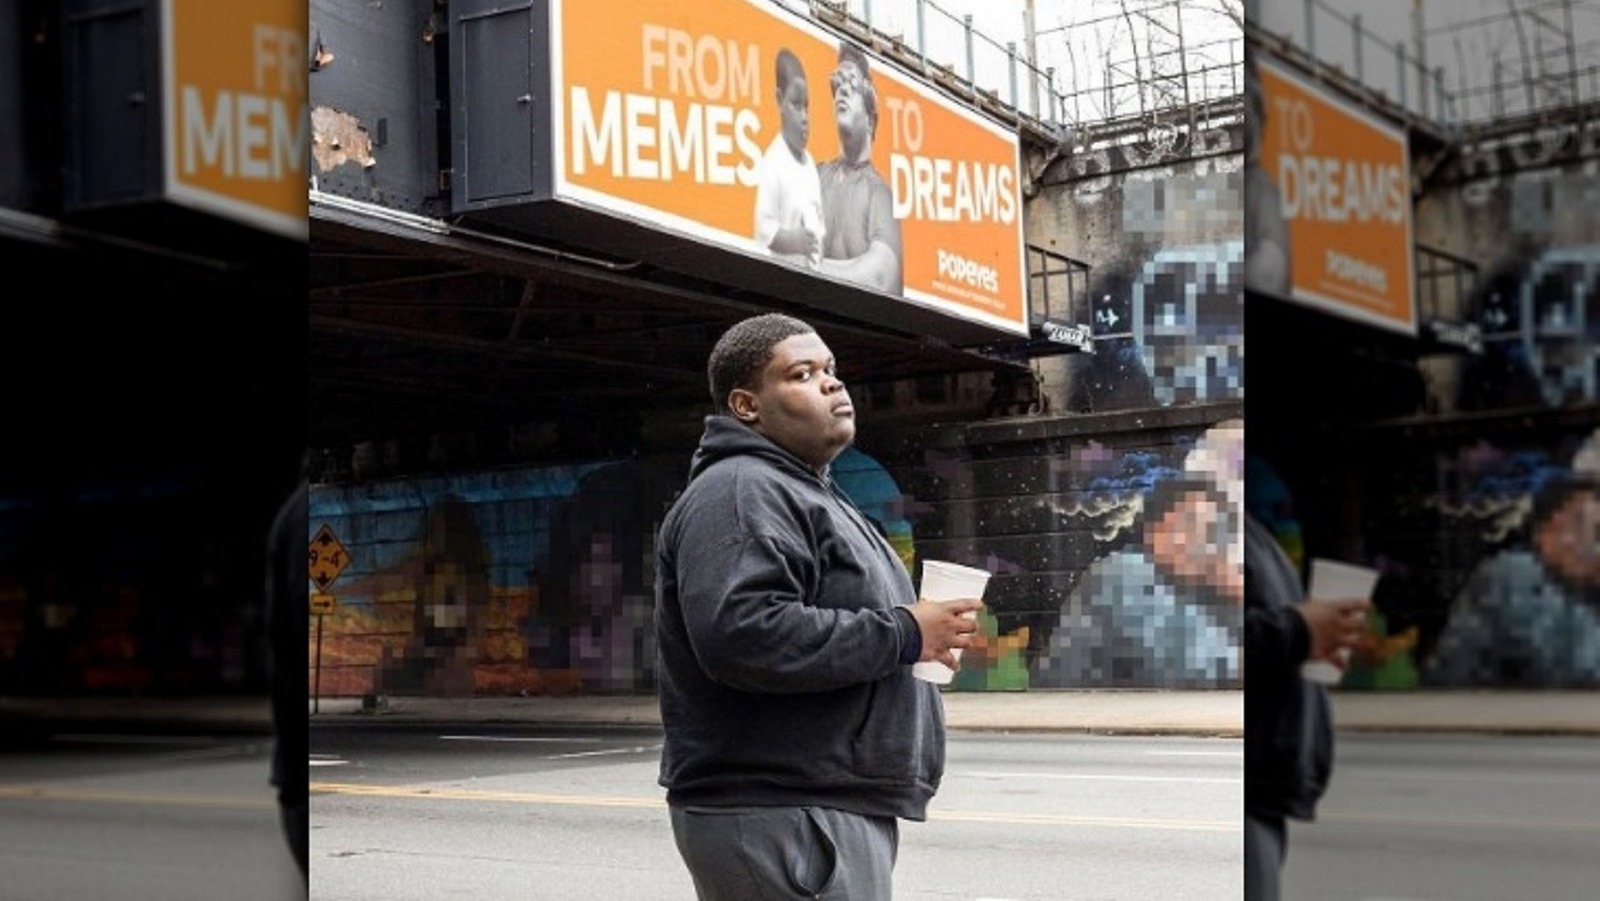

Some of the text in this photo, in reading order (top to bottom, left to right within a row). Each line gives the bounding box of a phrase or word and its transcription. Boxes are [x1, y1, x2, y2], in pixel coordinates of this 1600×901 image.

[642, 23, 760, 106] FROM
[571, 86, 762, 187] MEMES
[886, 98, 923, 152] TO
[1273, 98, 1314, 151] TO
[890, 153, 1015, 225] DREAMS
[1278, 154, 1404, 226] DREAMS
